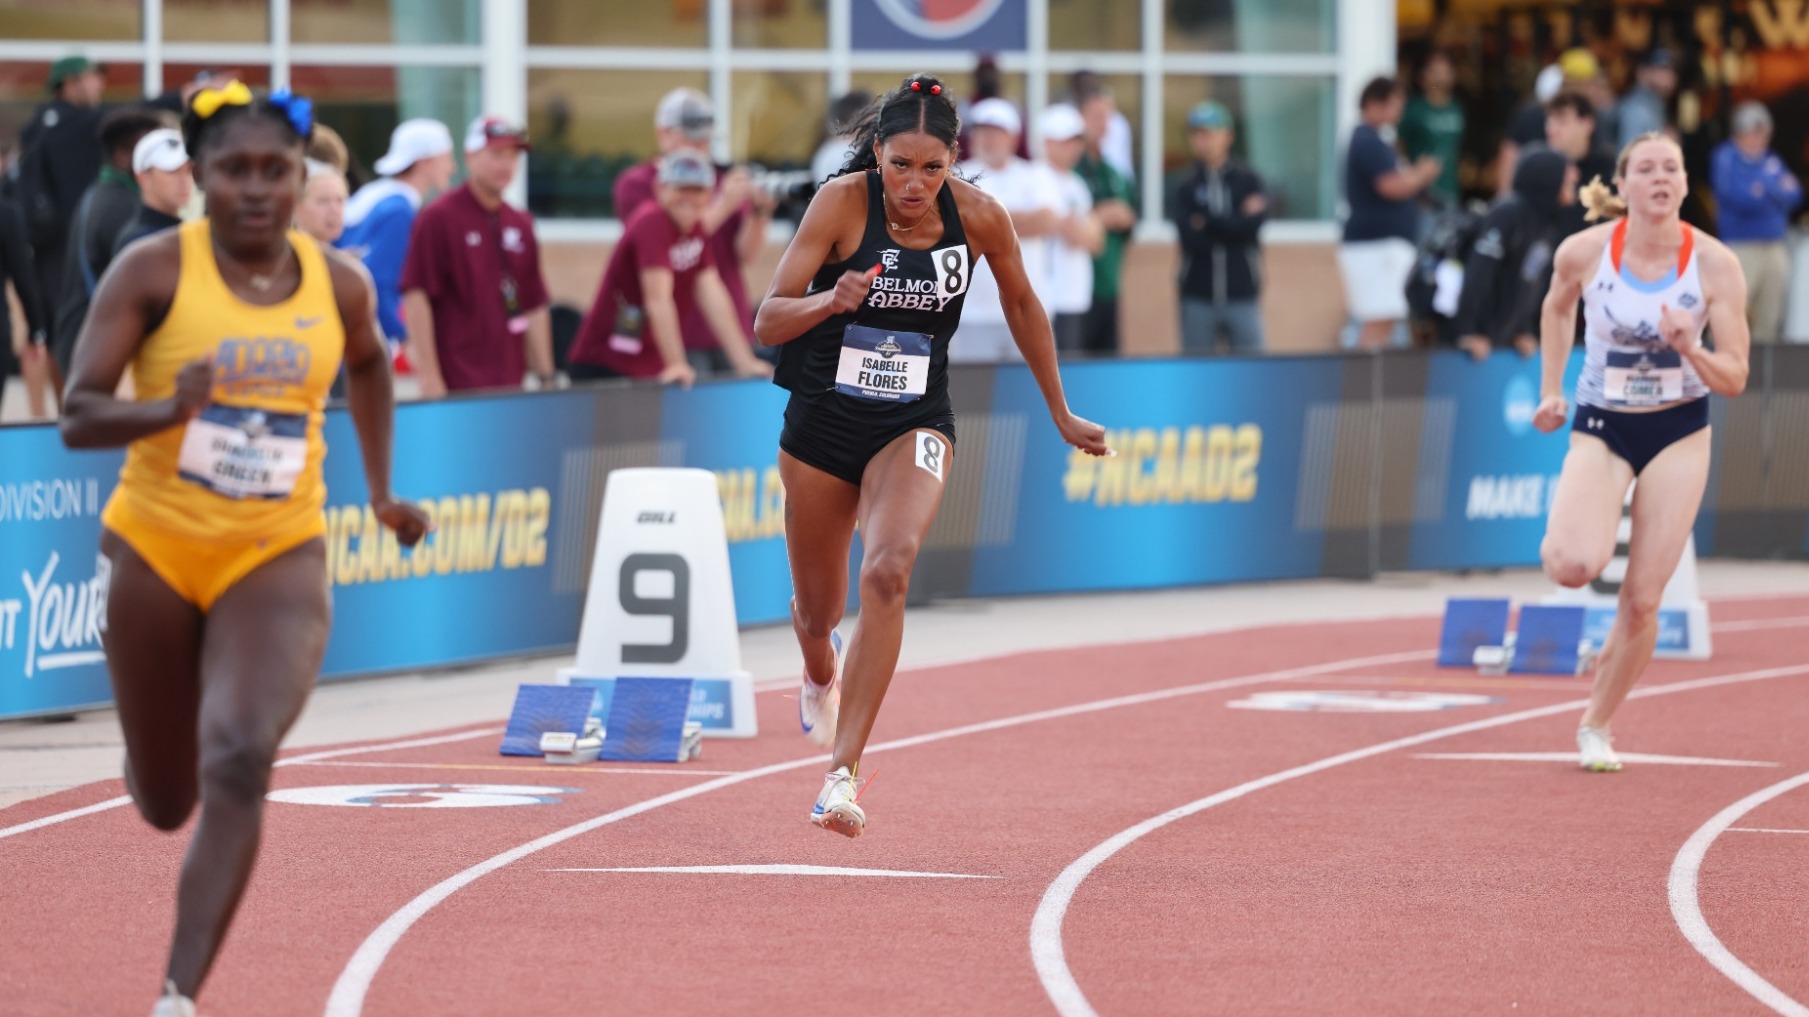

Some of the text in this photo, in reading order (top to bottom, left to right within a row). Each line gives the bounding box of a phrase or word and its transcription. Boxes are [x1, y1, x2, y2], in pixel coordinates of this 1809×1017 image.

[941, 250, 962, 294] 8
[868, 291, 955, 312] ABBEY
[858, 371, 908, 390] FLORES
[861, 357, 908, 372] ISABELLE
[924, 436, 940, 473] 8
[1063, 423, 1262, 506] #NCAAD2
[1465, 475, 1544, 520] MAKE
[636, 510, 676, 525] GILL
[619, 552, 690, 664] 9
